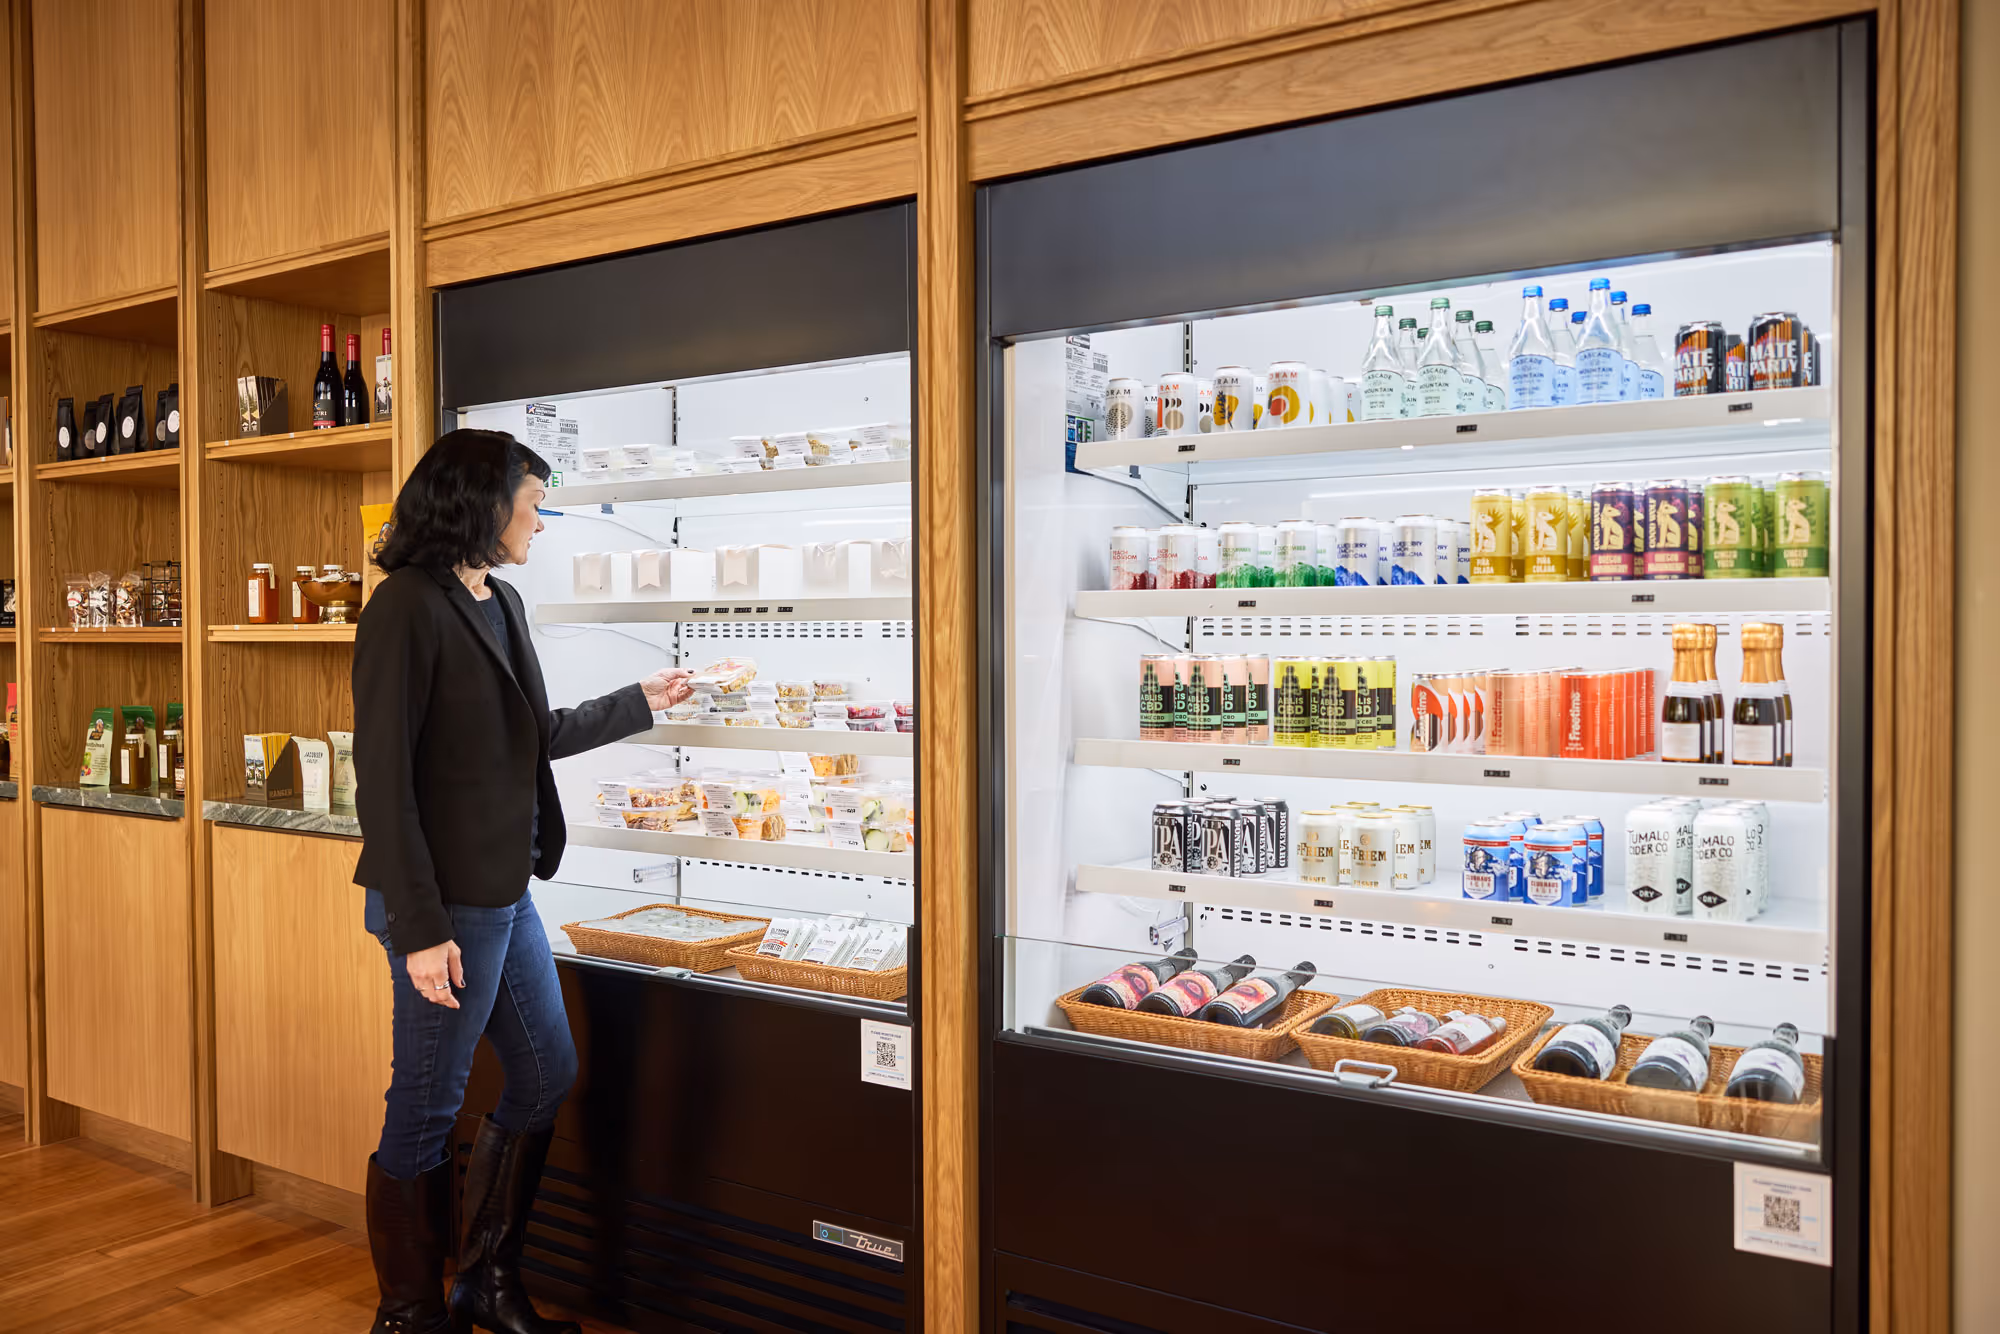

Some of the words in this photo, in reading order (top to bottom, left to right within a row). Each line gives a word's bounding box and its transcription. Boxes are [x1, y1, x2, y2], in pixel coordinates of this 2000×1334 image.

[1750, 339, 1797, 362] MATE
[1749, 357, 1798, 376] PARTY
[1674, 366, 1715, 382] ARTY
[1140, 694, 1163, 702] ABLIS
[1188, 695, 1210, 703] ABLIS
[1278, 697, 1304, 705] ABLIS
[1320, 698, 1345, 706] ABLIS
[1140, 701, 1163, 712] CBD
[1188, 703, 1210, 713] CBD
[1278, 705, 1304, 715] CBD
[1320, 706, 1345, 717] CBD
[1568, 692, 1581, 741] Freetime
[1153, 825, 1183, 861] IPA
[1279, 811, 1288, 867] BONEYARD
[1200, 828, 1229, 865] IPA
[1639, 890, 1654, 898] DRY
[1702, 895, 1718, 904] DRY
[849, 1234, 896, 1257] True
